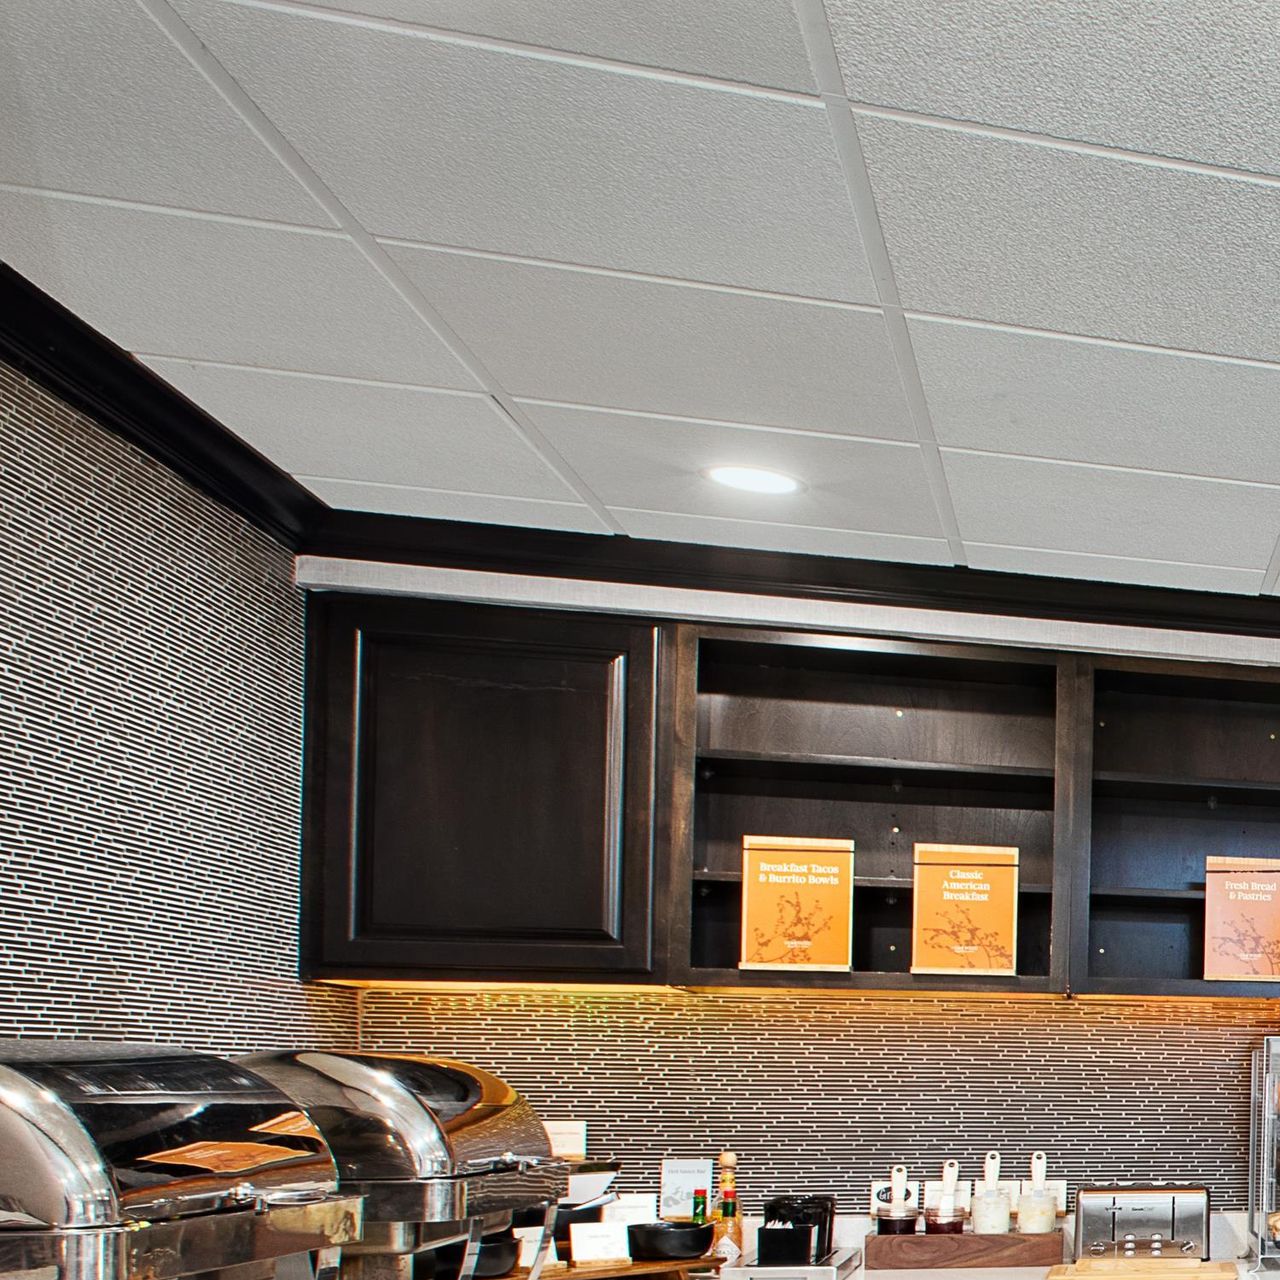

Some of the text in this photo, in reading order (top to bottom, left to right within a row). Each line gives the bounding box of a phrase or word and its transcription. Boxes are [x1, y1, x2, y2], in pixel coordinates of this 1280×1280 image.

[759, 862, 839, 874] Breakfast Tacos
[758, 873, 839, 885] & Burrito Bowls
[949, 869, 983, 880] Classic
[942, 880, 991, 892] American
[1225, 881, 1277, 891] Fresh Bread
[942, 891, 989, 902] Breakfast
[1228, 891, 1272, 902] & Pastries
